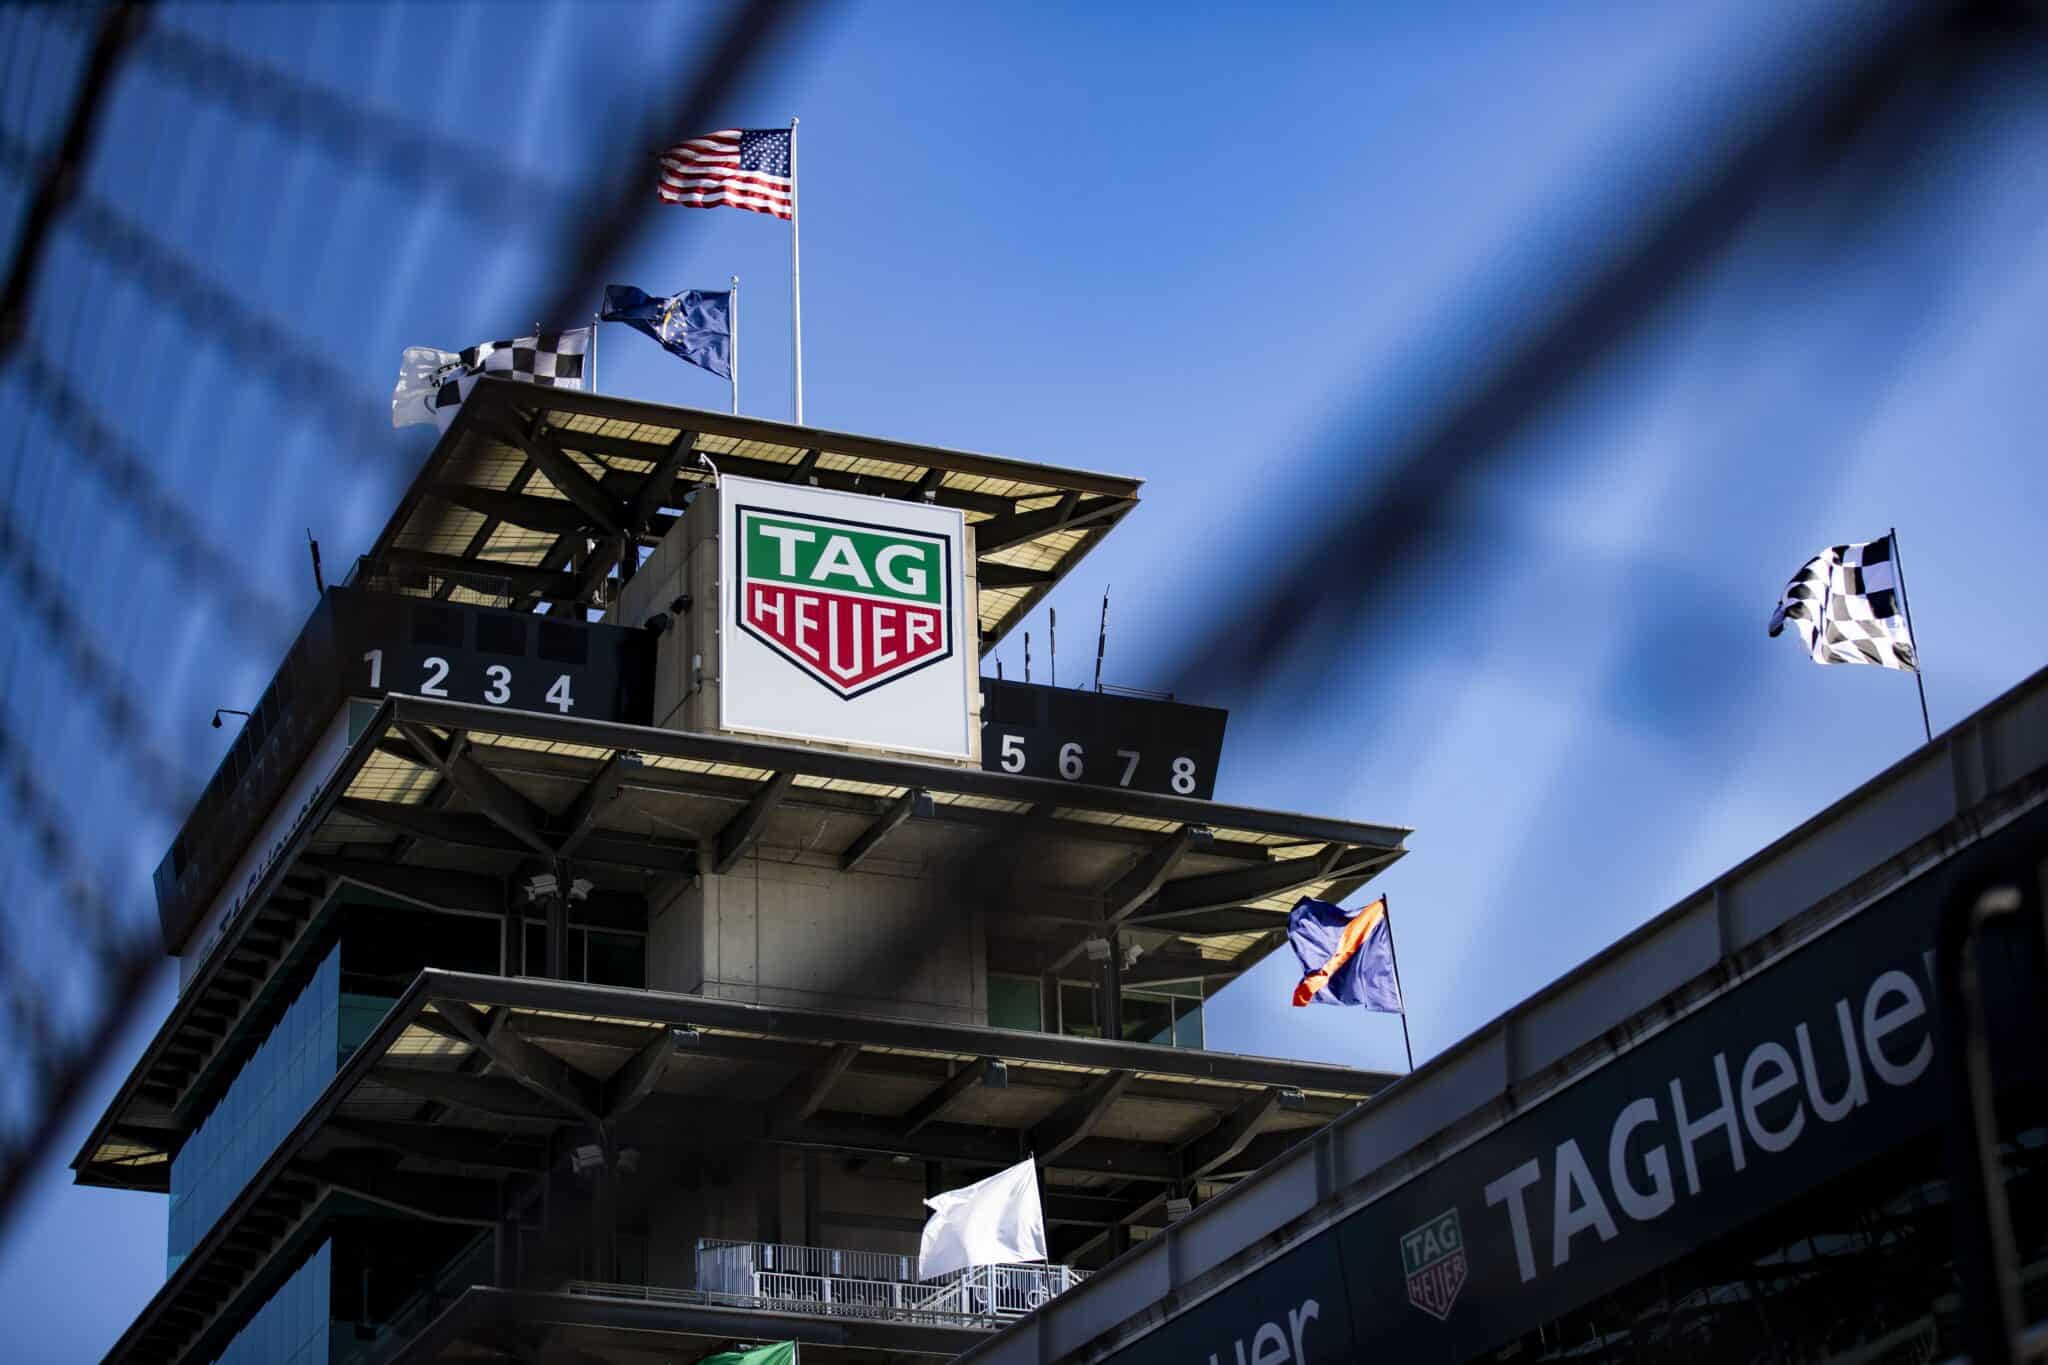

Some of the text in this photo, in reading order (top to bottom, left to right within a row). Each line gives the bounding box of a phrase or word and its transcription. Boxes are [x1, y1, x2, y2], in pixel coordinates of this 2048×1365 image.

[759, 524, 927, 596] TAG
[754, 590, 935, 681] HEUER
[364, 649, 574, 713] 1 2 3 4
[1000, 734, 1196, 794] 5 6 7 8
[1406, 1217, 1457, 1267] TAG
[1409, 1255, 1465, 1312] HEUER
